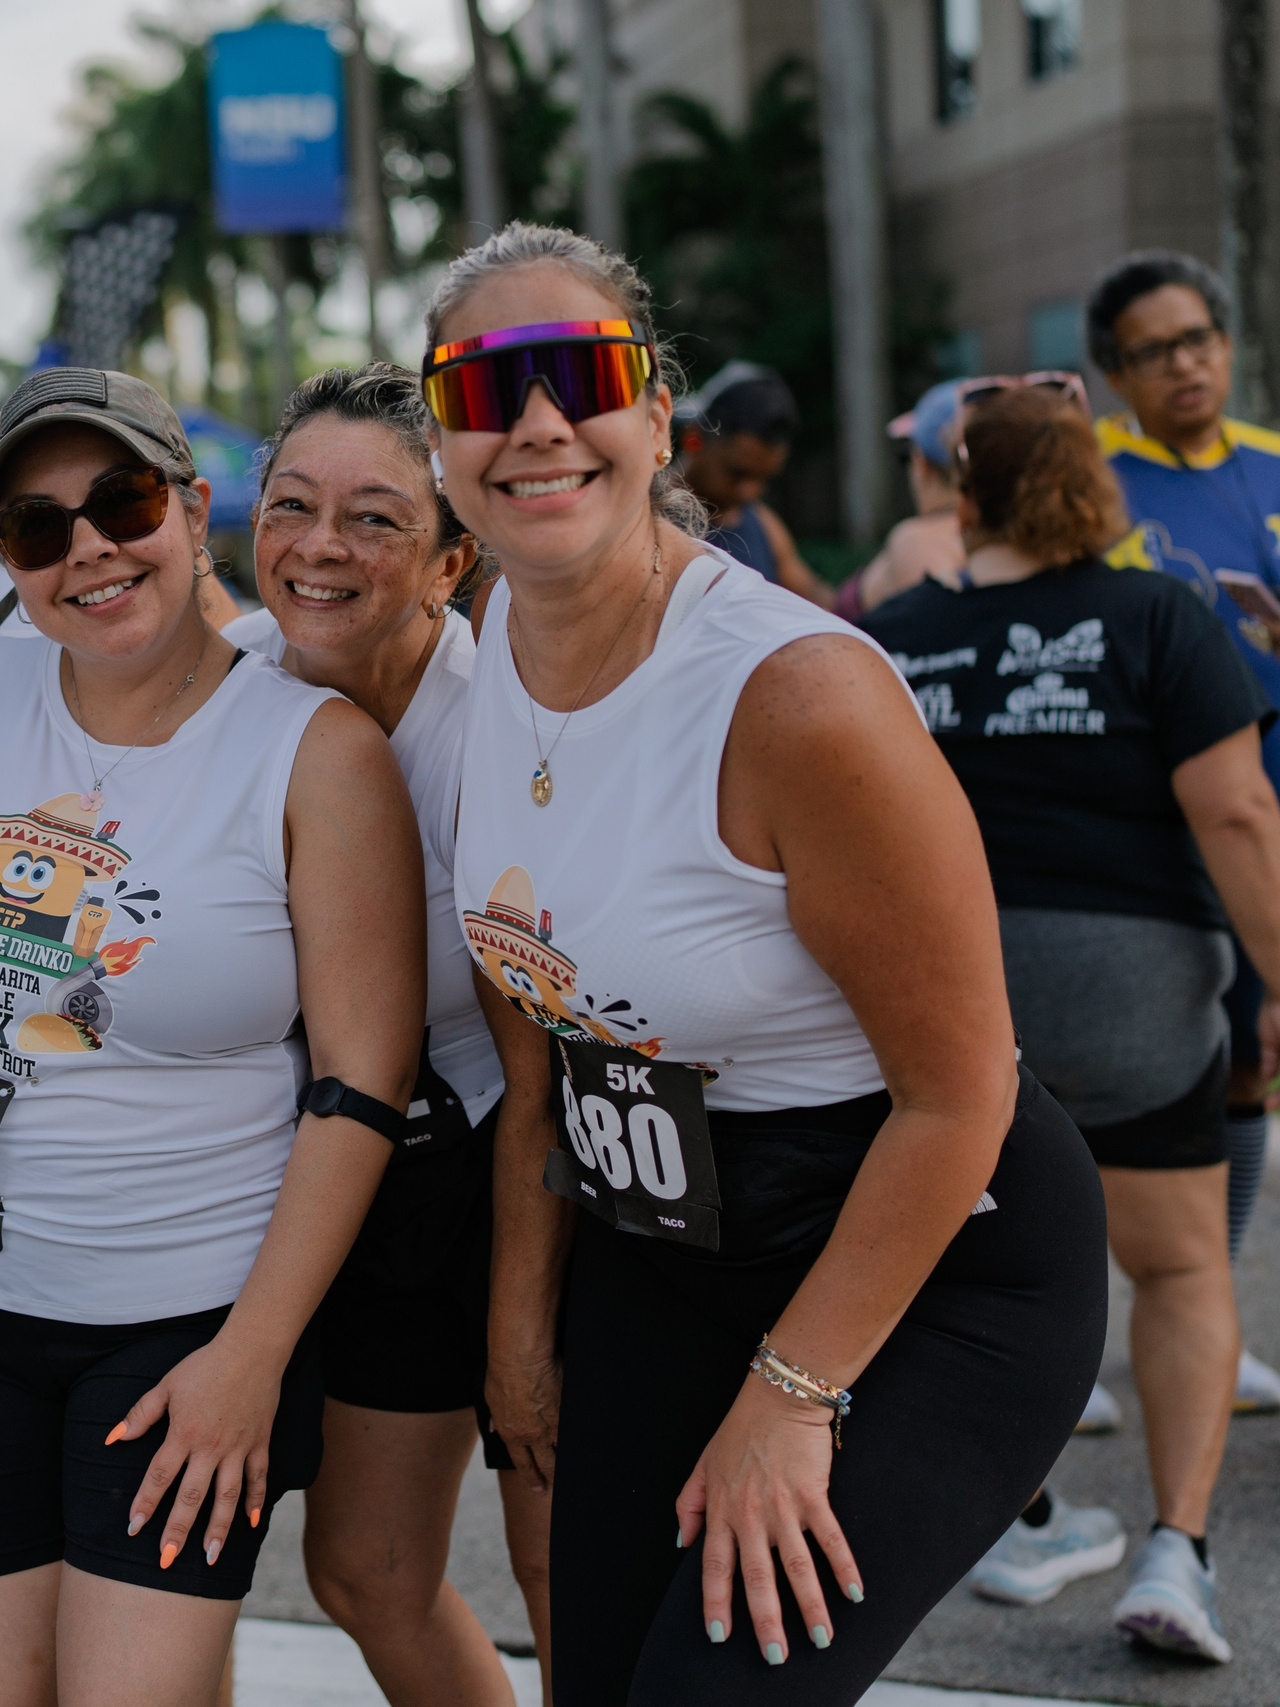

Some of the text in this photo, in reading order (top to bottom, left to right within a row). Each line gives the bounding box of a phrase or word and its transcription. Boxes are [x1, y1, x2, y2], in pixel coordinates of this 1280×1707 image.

[984, 710, 1106, 737] PREMIER
[6, 938, 74, 974] DRINKO
[606, 1063, 656, 1095] 5K
[404, 1133, 432, 1146] TACO
[562, 1075, 688, 1200] 880
[581, 1181, 597, 1198] BEER
[657, 1216, 686, 1229] TACO
